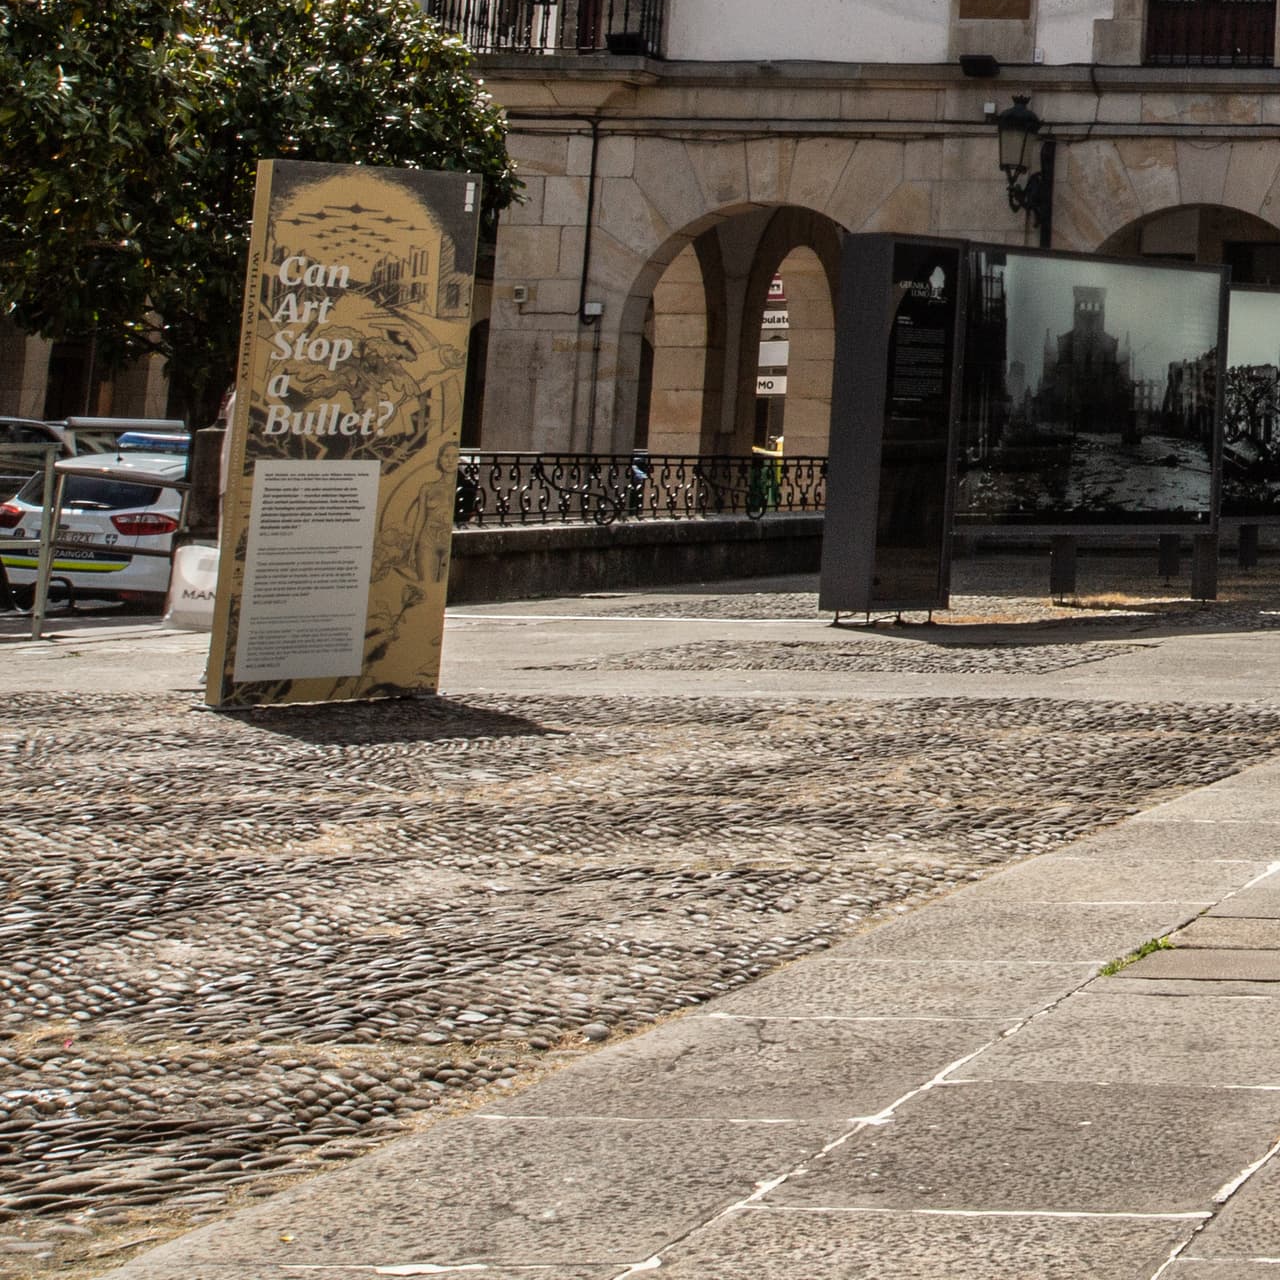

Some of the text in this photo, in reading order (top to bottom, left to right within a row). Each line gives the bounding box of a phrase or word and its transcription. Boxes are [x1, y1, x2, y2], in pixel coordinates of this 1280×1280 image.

[279, 256, 350, 288] Can
[270, 293, 334, 323] Art
[270, 330, 353, 370] Stop
[266, 372, 290, 398] a
[262, 401, 394, 436] Bullet?
